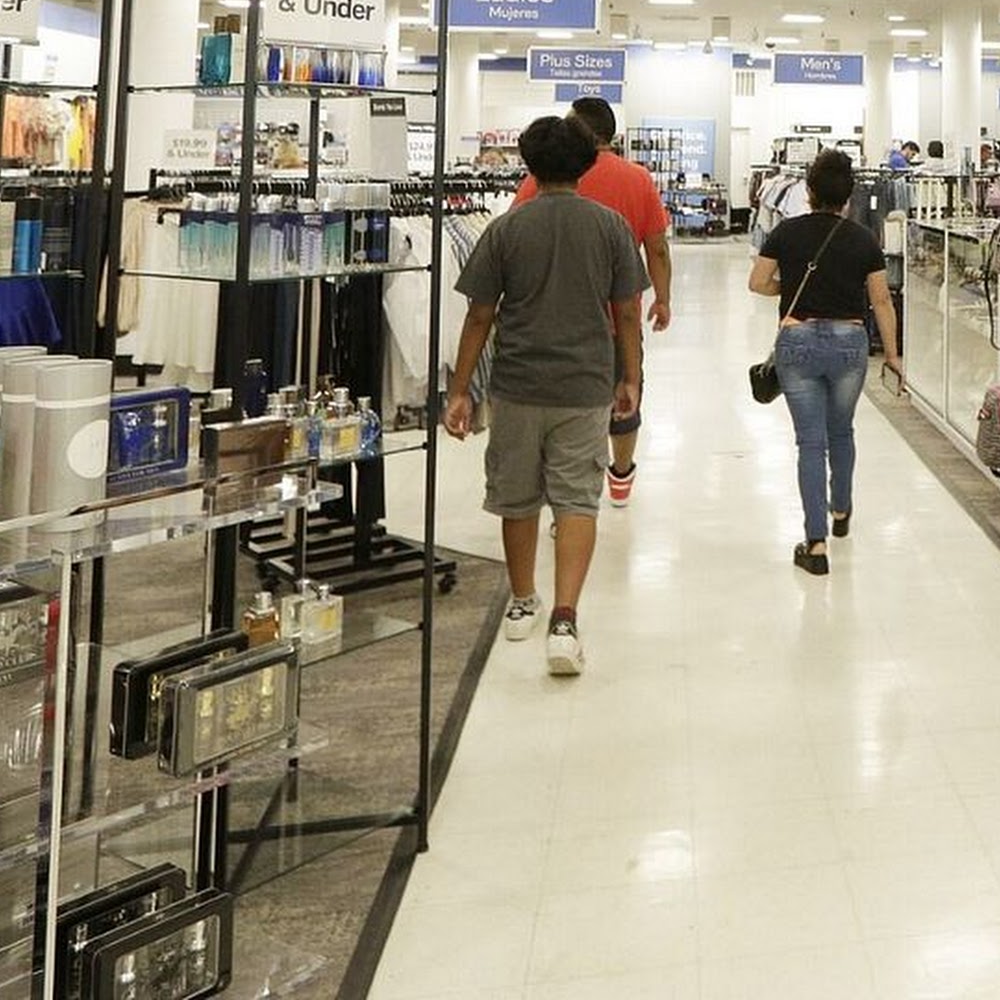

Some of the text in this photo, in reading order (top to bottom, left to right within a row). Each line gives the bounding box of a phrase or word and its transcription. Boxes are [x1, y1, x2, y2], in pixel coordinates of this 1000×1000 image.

[489, 6, 539, 21] Mujeres
[540, 53, 613, 69] Plus Sizes
[800, 56, 842, 71] Men's
